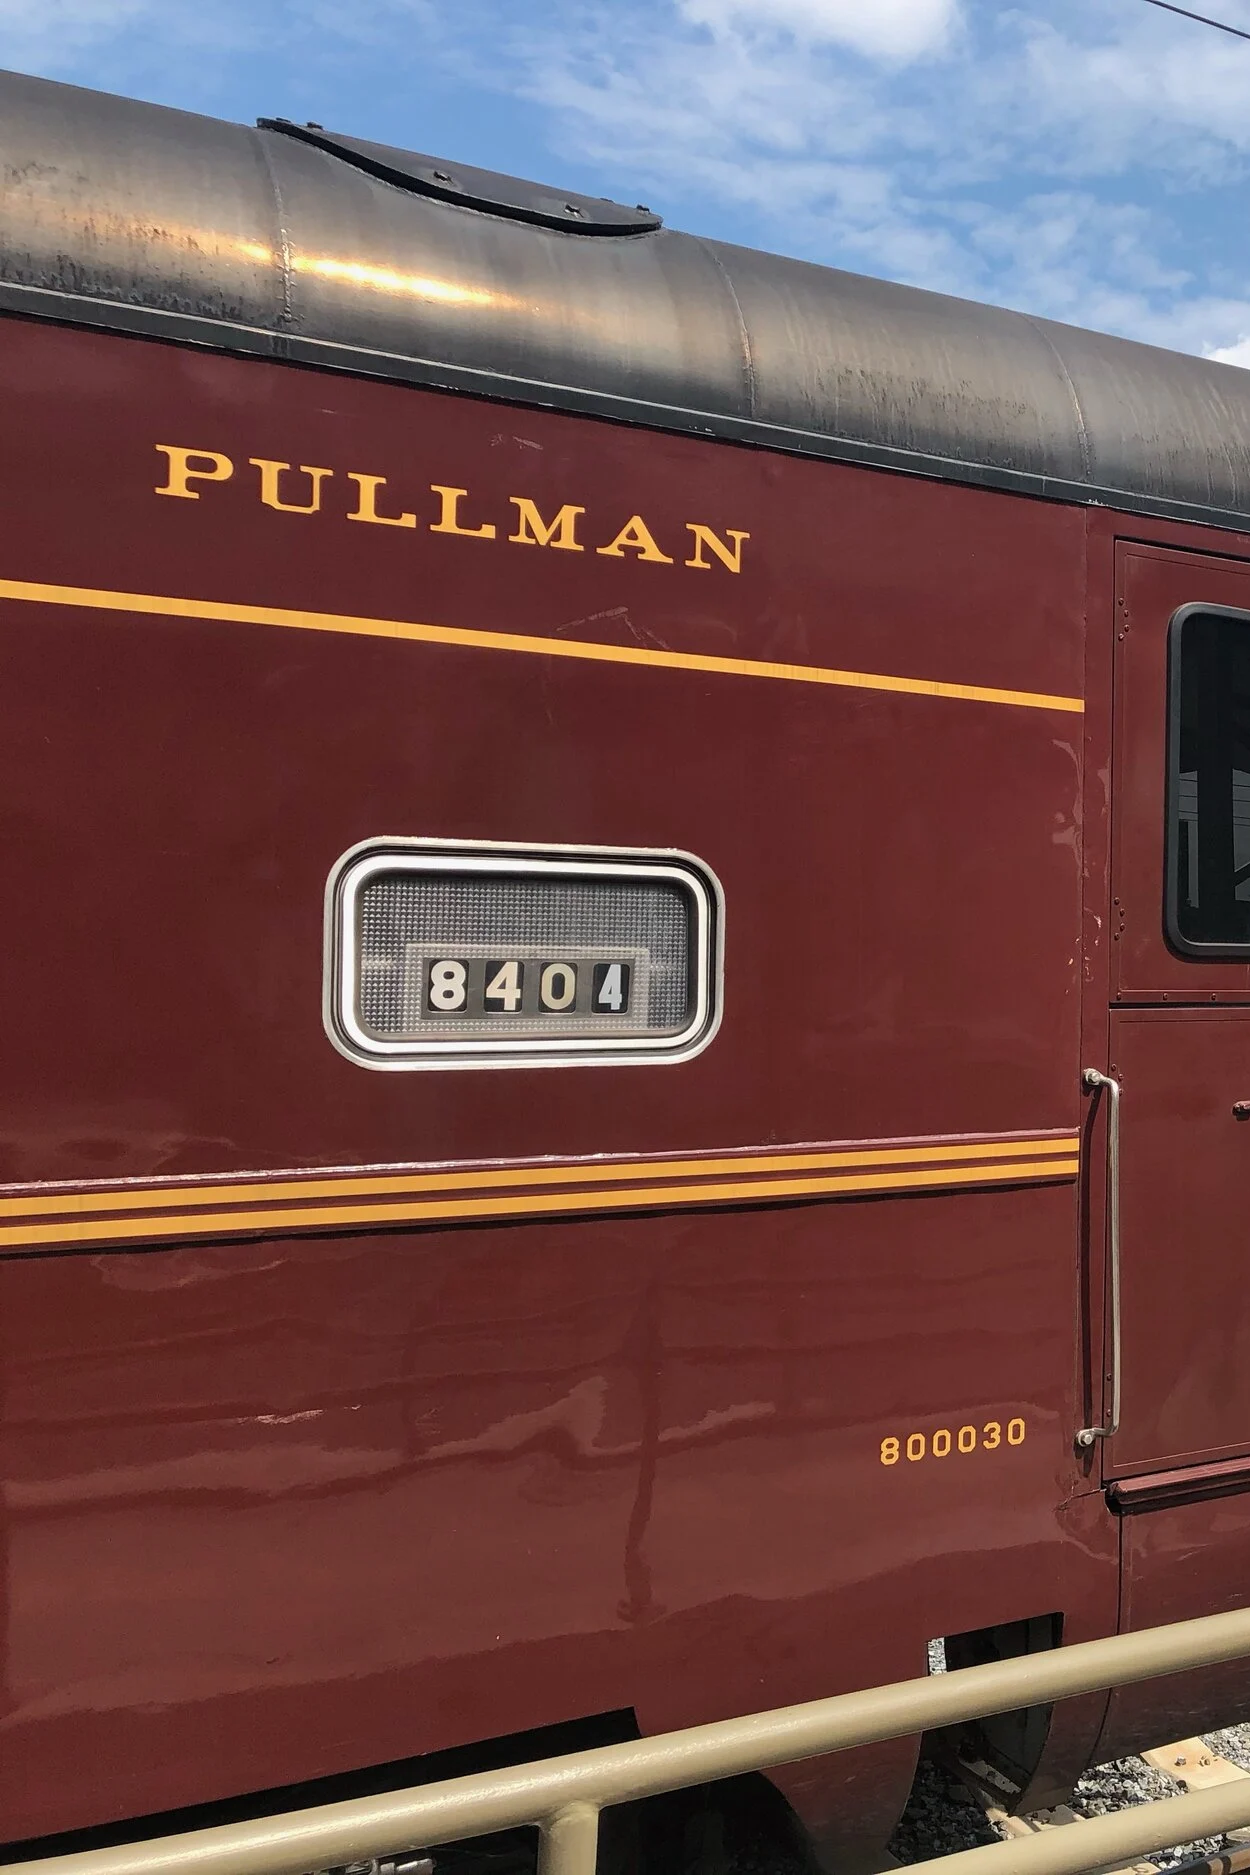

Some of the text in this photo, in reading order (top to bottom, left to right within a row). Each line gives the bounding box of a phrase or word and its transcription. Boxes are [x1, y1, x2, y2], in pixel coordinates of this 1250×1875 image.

[155, 444, 750, 573] PULLMAN
[430, 960, 622, 1011] 8404
[880, 1417, 1025, 1466] 800030
